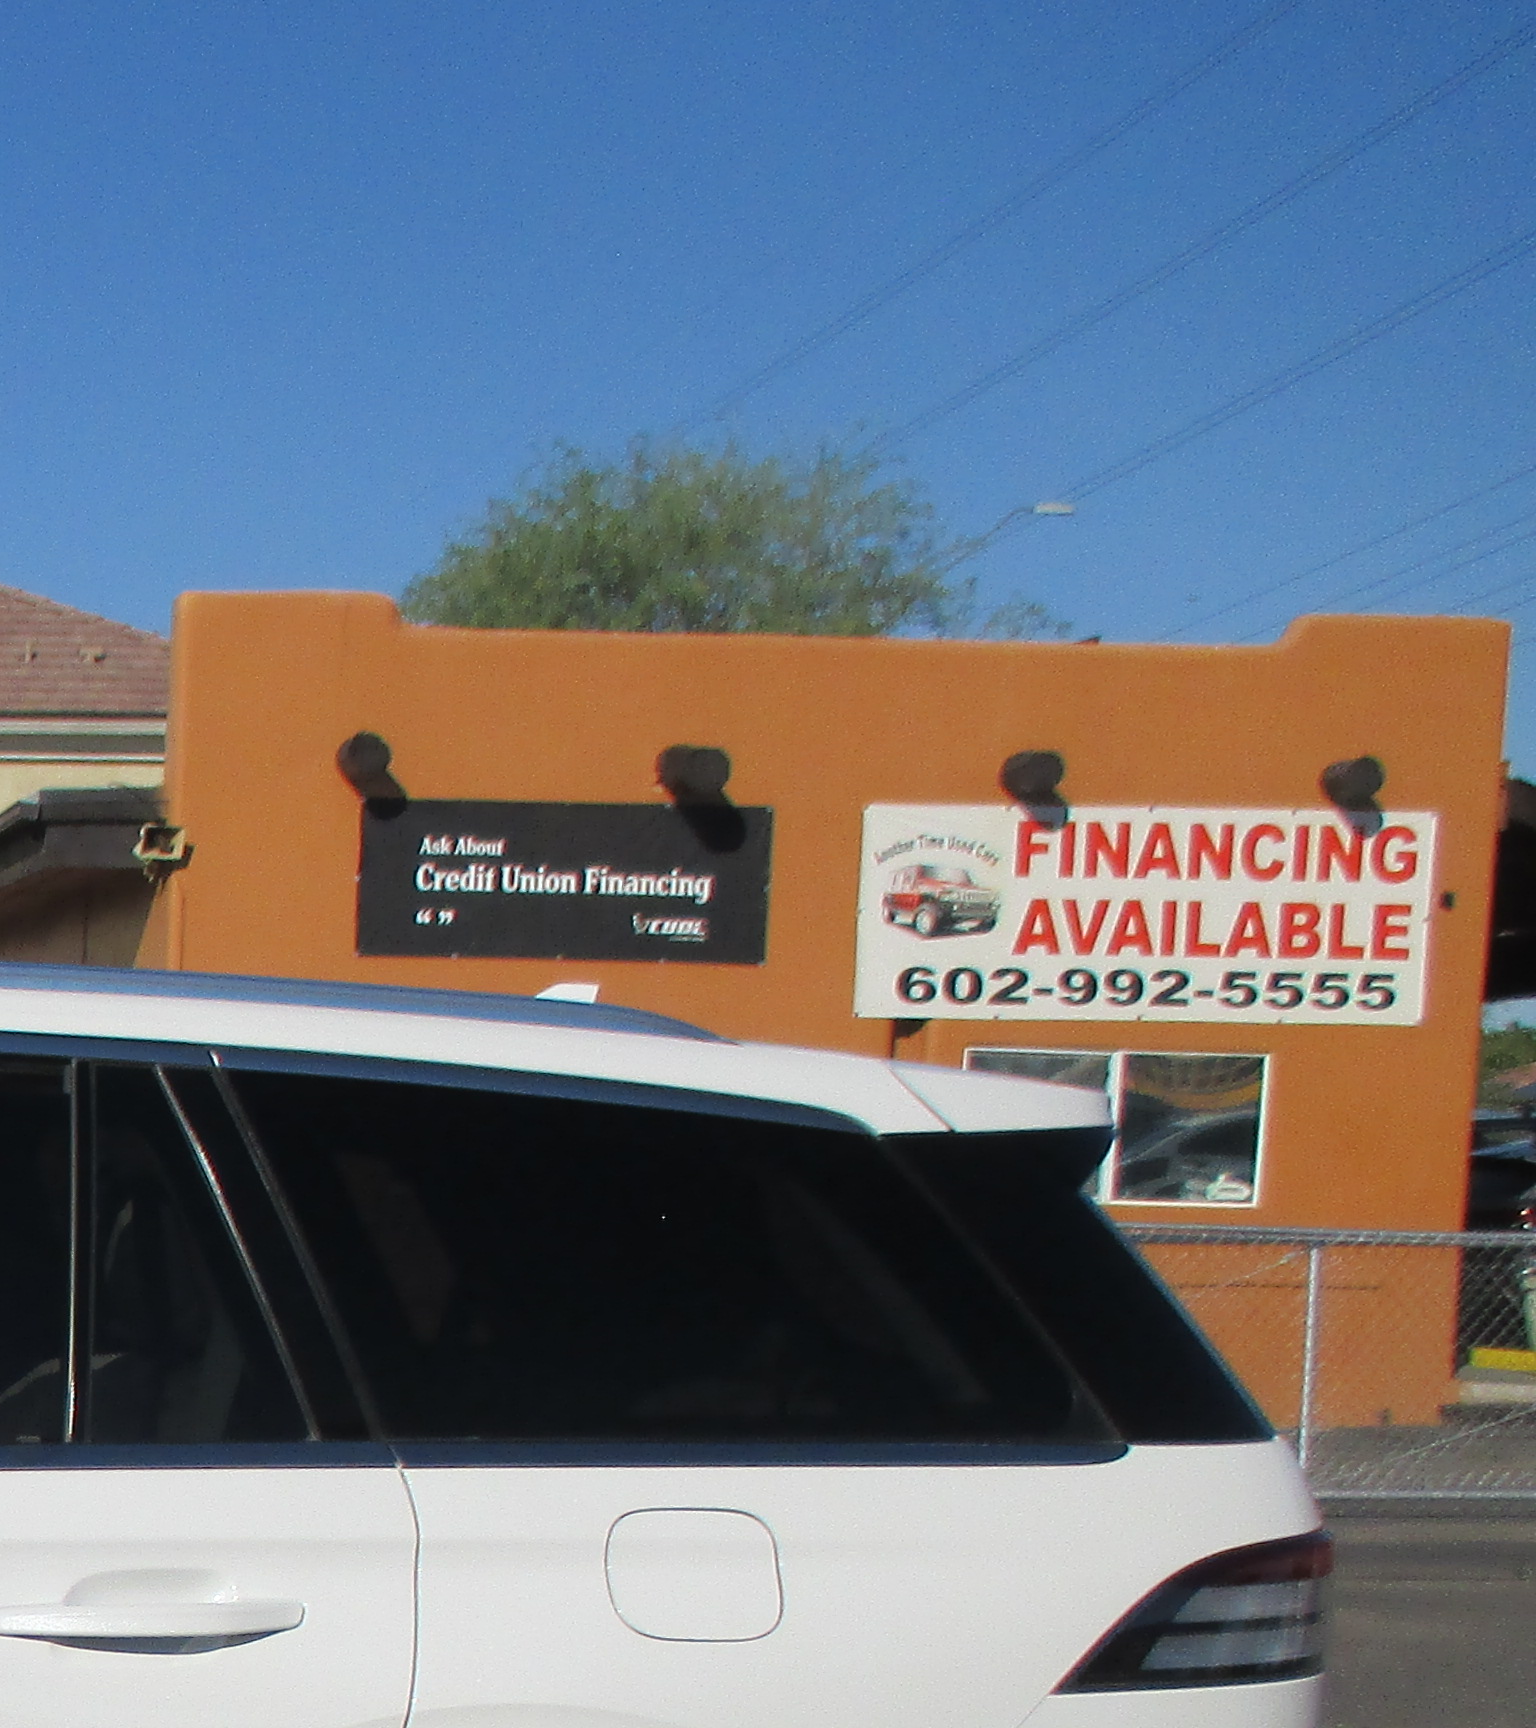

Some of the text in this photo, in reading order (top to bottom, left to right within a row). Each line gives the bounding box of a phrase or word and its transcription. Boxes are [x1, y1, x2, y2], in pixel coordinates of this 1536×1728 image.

[419, 836, 506, 857] Ask About
[1012, 820, 1420, 884] FINANCING
[414, 863, 714, 905] Credit Union Financing
[1010, 897, 1412, 961] AVAILABLE
[895, 965, 1398, 1011] 602-992-5555
